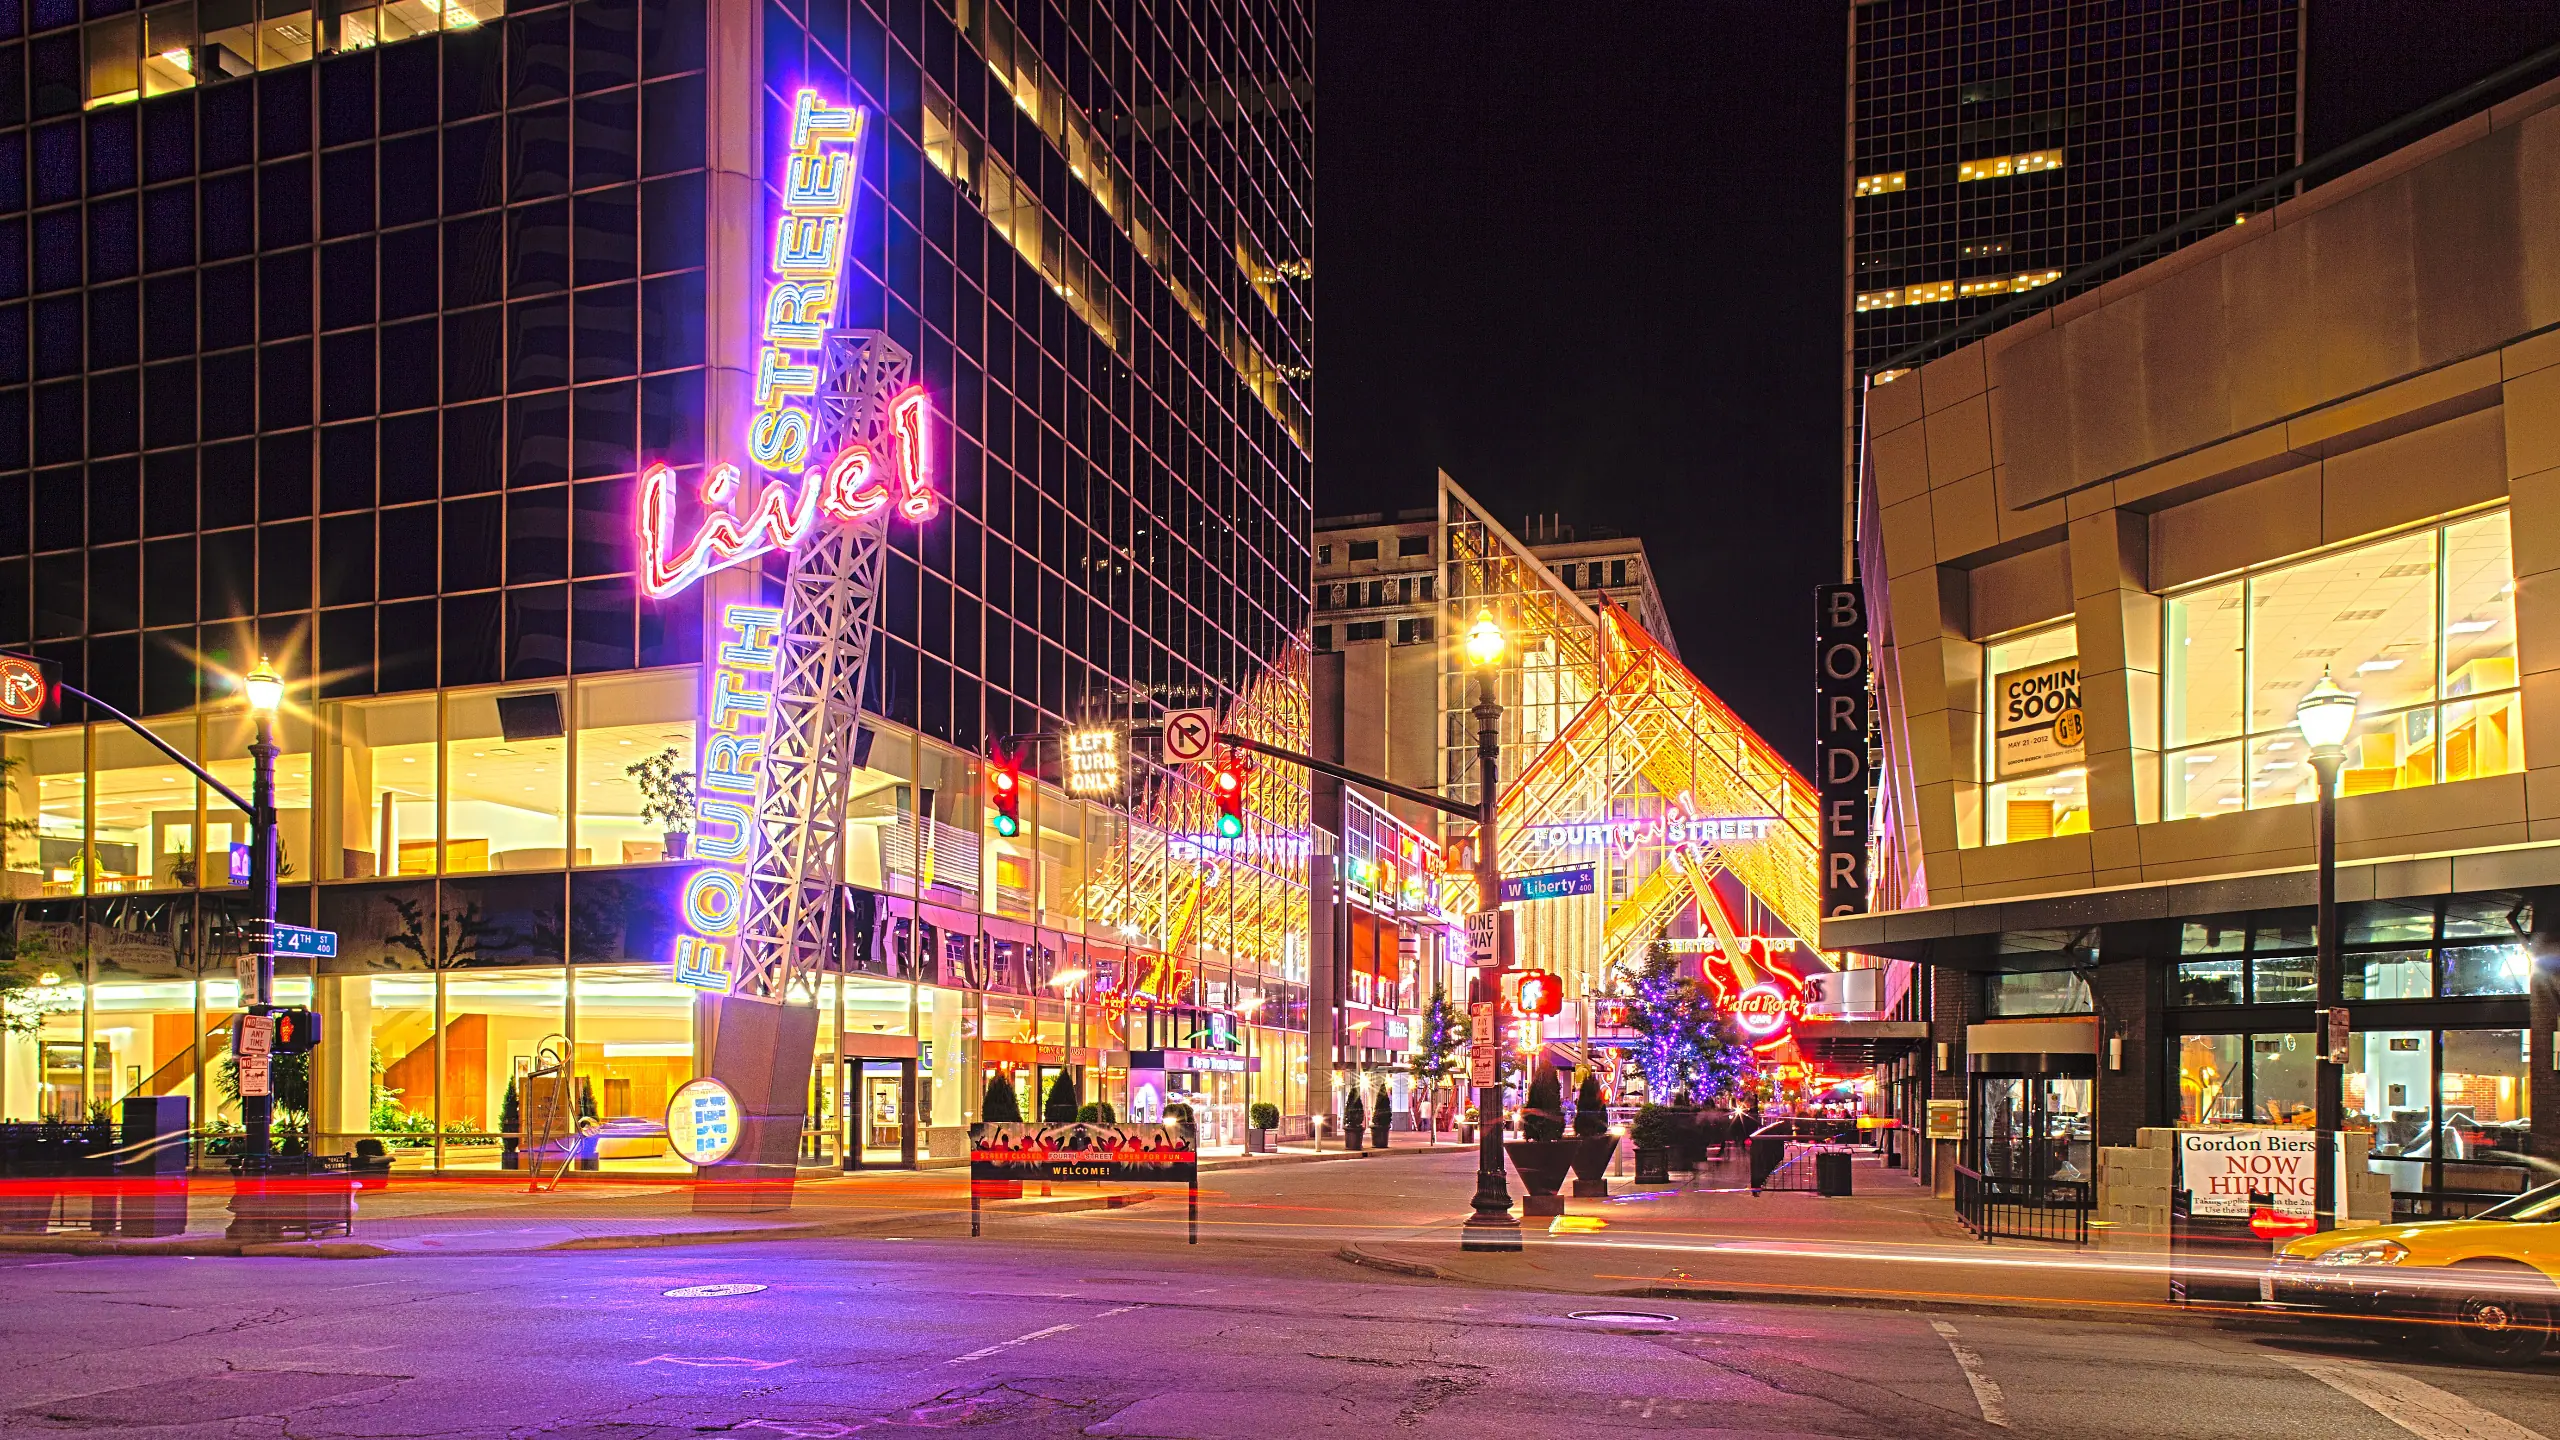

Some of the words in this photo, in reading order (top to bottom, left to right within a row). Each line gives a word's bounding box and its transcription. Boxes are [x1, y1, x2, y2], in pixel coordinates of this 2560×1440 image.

[748, 88, 862, 473] STREET
[637, 384, 938, 598] Live!
[2008, 686, 2082, 722] SOON
[1069, 731, 1113, 752] LEFT
[2033, 736, 2048, 744] 2012
[1071, 752, 1116, 771] TURN
[1072, 771, 1118, 790] ONLY
[673, 604, 785, 994] FOURTH
[1533, 823, 1635, 847] FOURTH
[1668, 819, 1769, 842] STREET
[1508, 883, 1522, 897] W
[1527, 878, 1576, 895] Liberty
[1580, 873, 1591, 882] St.
[1579, 884, 1592, 892] 400
[1469, 914, 1494, 931] ONE
[288, 933, 312, 950] 4TH
[319, 936, 328, 944] ST
[1468, 931, 1494, 948] WAY
[317, 945, 331, 953] 400
[239, 959, 255, 974] ONE
[240, 974, 255, 990] WAY
[1762, 994, 1800, 1015] Rock
[246, 1017, 256, 1027] NO
[1748, 1015, 1772, 1024] CAFE
[250, 1038, 264, 1047] TIME
[251, 1030, 265, 1038] ANY
[242, 1058, 250, 1067] NO
[251, 1059, 267, 1067] STOPPING
[2186, 1136, 2261, 1151] Gordon
[980, 1152, 1008, 1160] STREET
[1048, 1152, 1077, 1160] FOURTH
[1086, 1152, 1113, 1160] STREET
[1053, 1166, 1111, 1175] WELCOME!
[2226, 1155, 2302, 1175] NOW
[2209, 1176, 2315, 1196] HIRING
[2193, 1197, 2221, 1206] Taking
